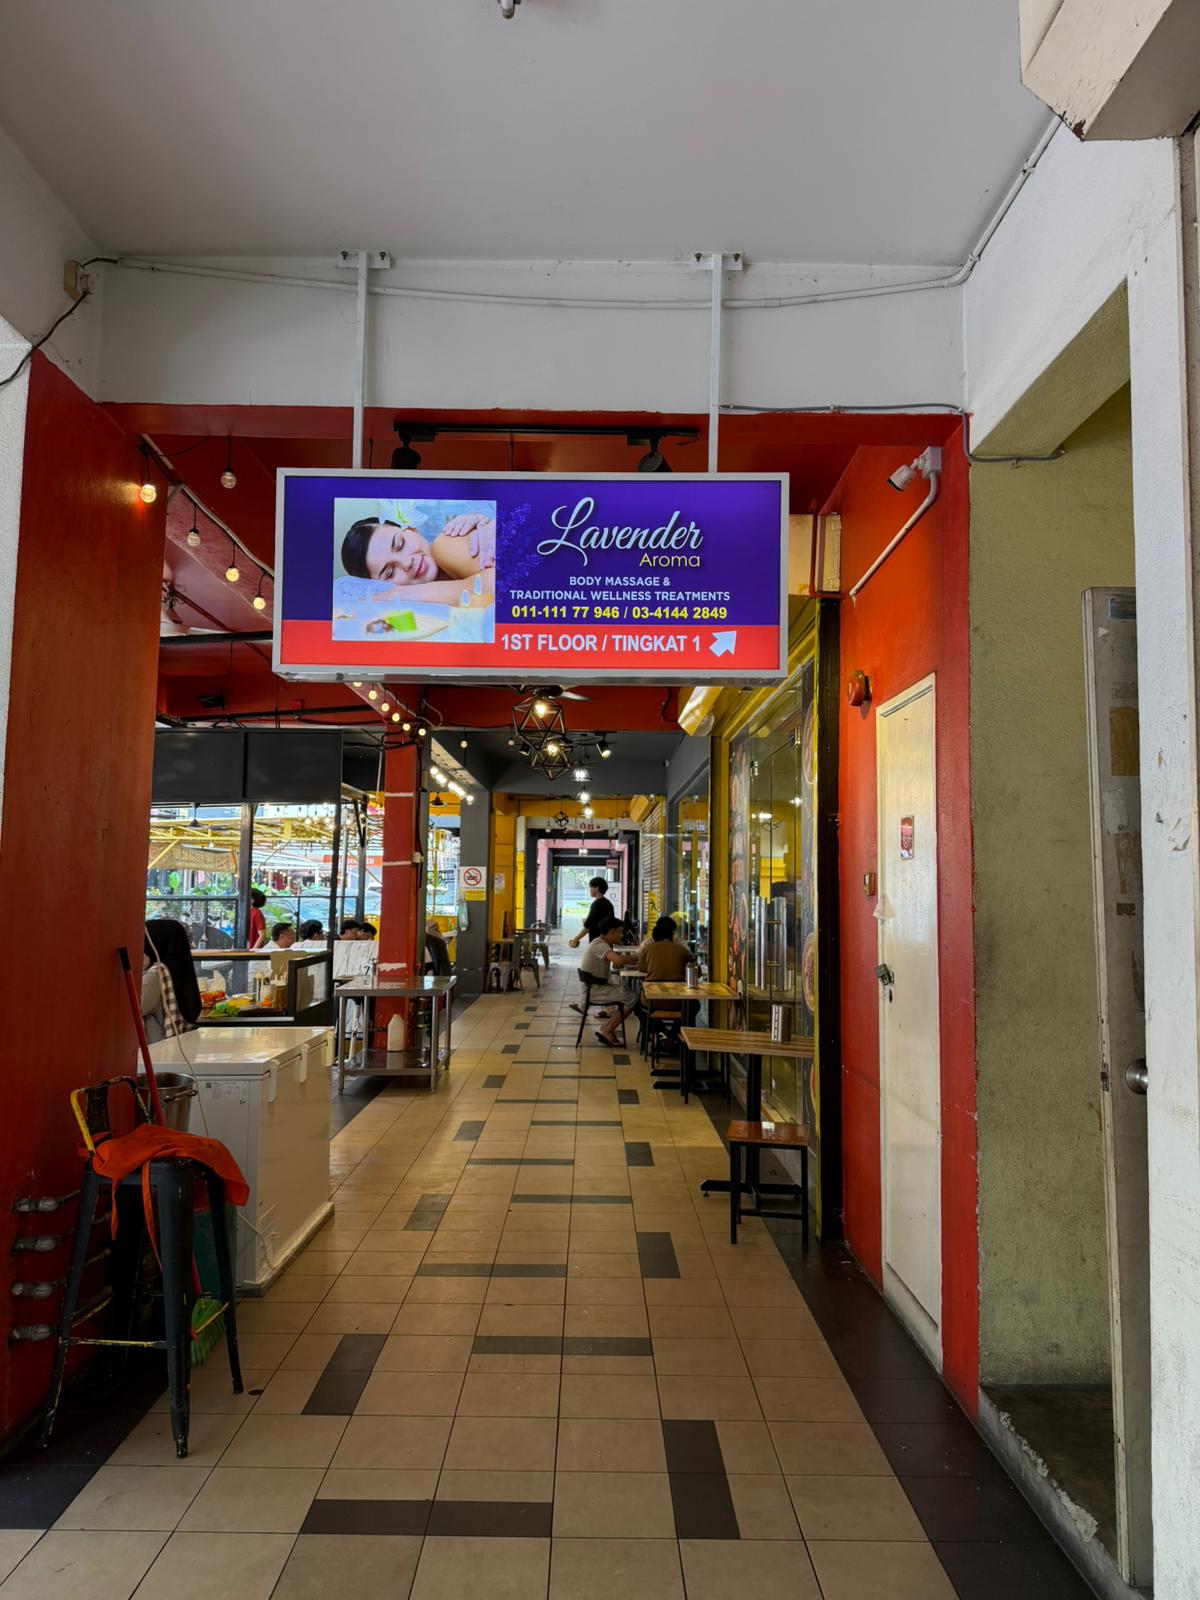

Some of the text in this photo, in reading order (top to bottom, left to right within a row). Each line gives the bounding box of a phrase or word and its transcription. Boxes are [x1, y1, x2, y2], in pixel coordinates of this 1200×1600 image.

[536, 496, 704, 567] Lavender
[639, 553, 700, 567] Aroma
[569, 576, 671, 586] BODY MASSAGE &
[509, 590, 731, 601] TRADITIONAL WELLNESS TREATMENTS
[511, 605, 728, 619] 011-111 77 946 / 03-4144 2849
[501, 633, 700, 652] 1ST FLOOR / TINGKAT 1
